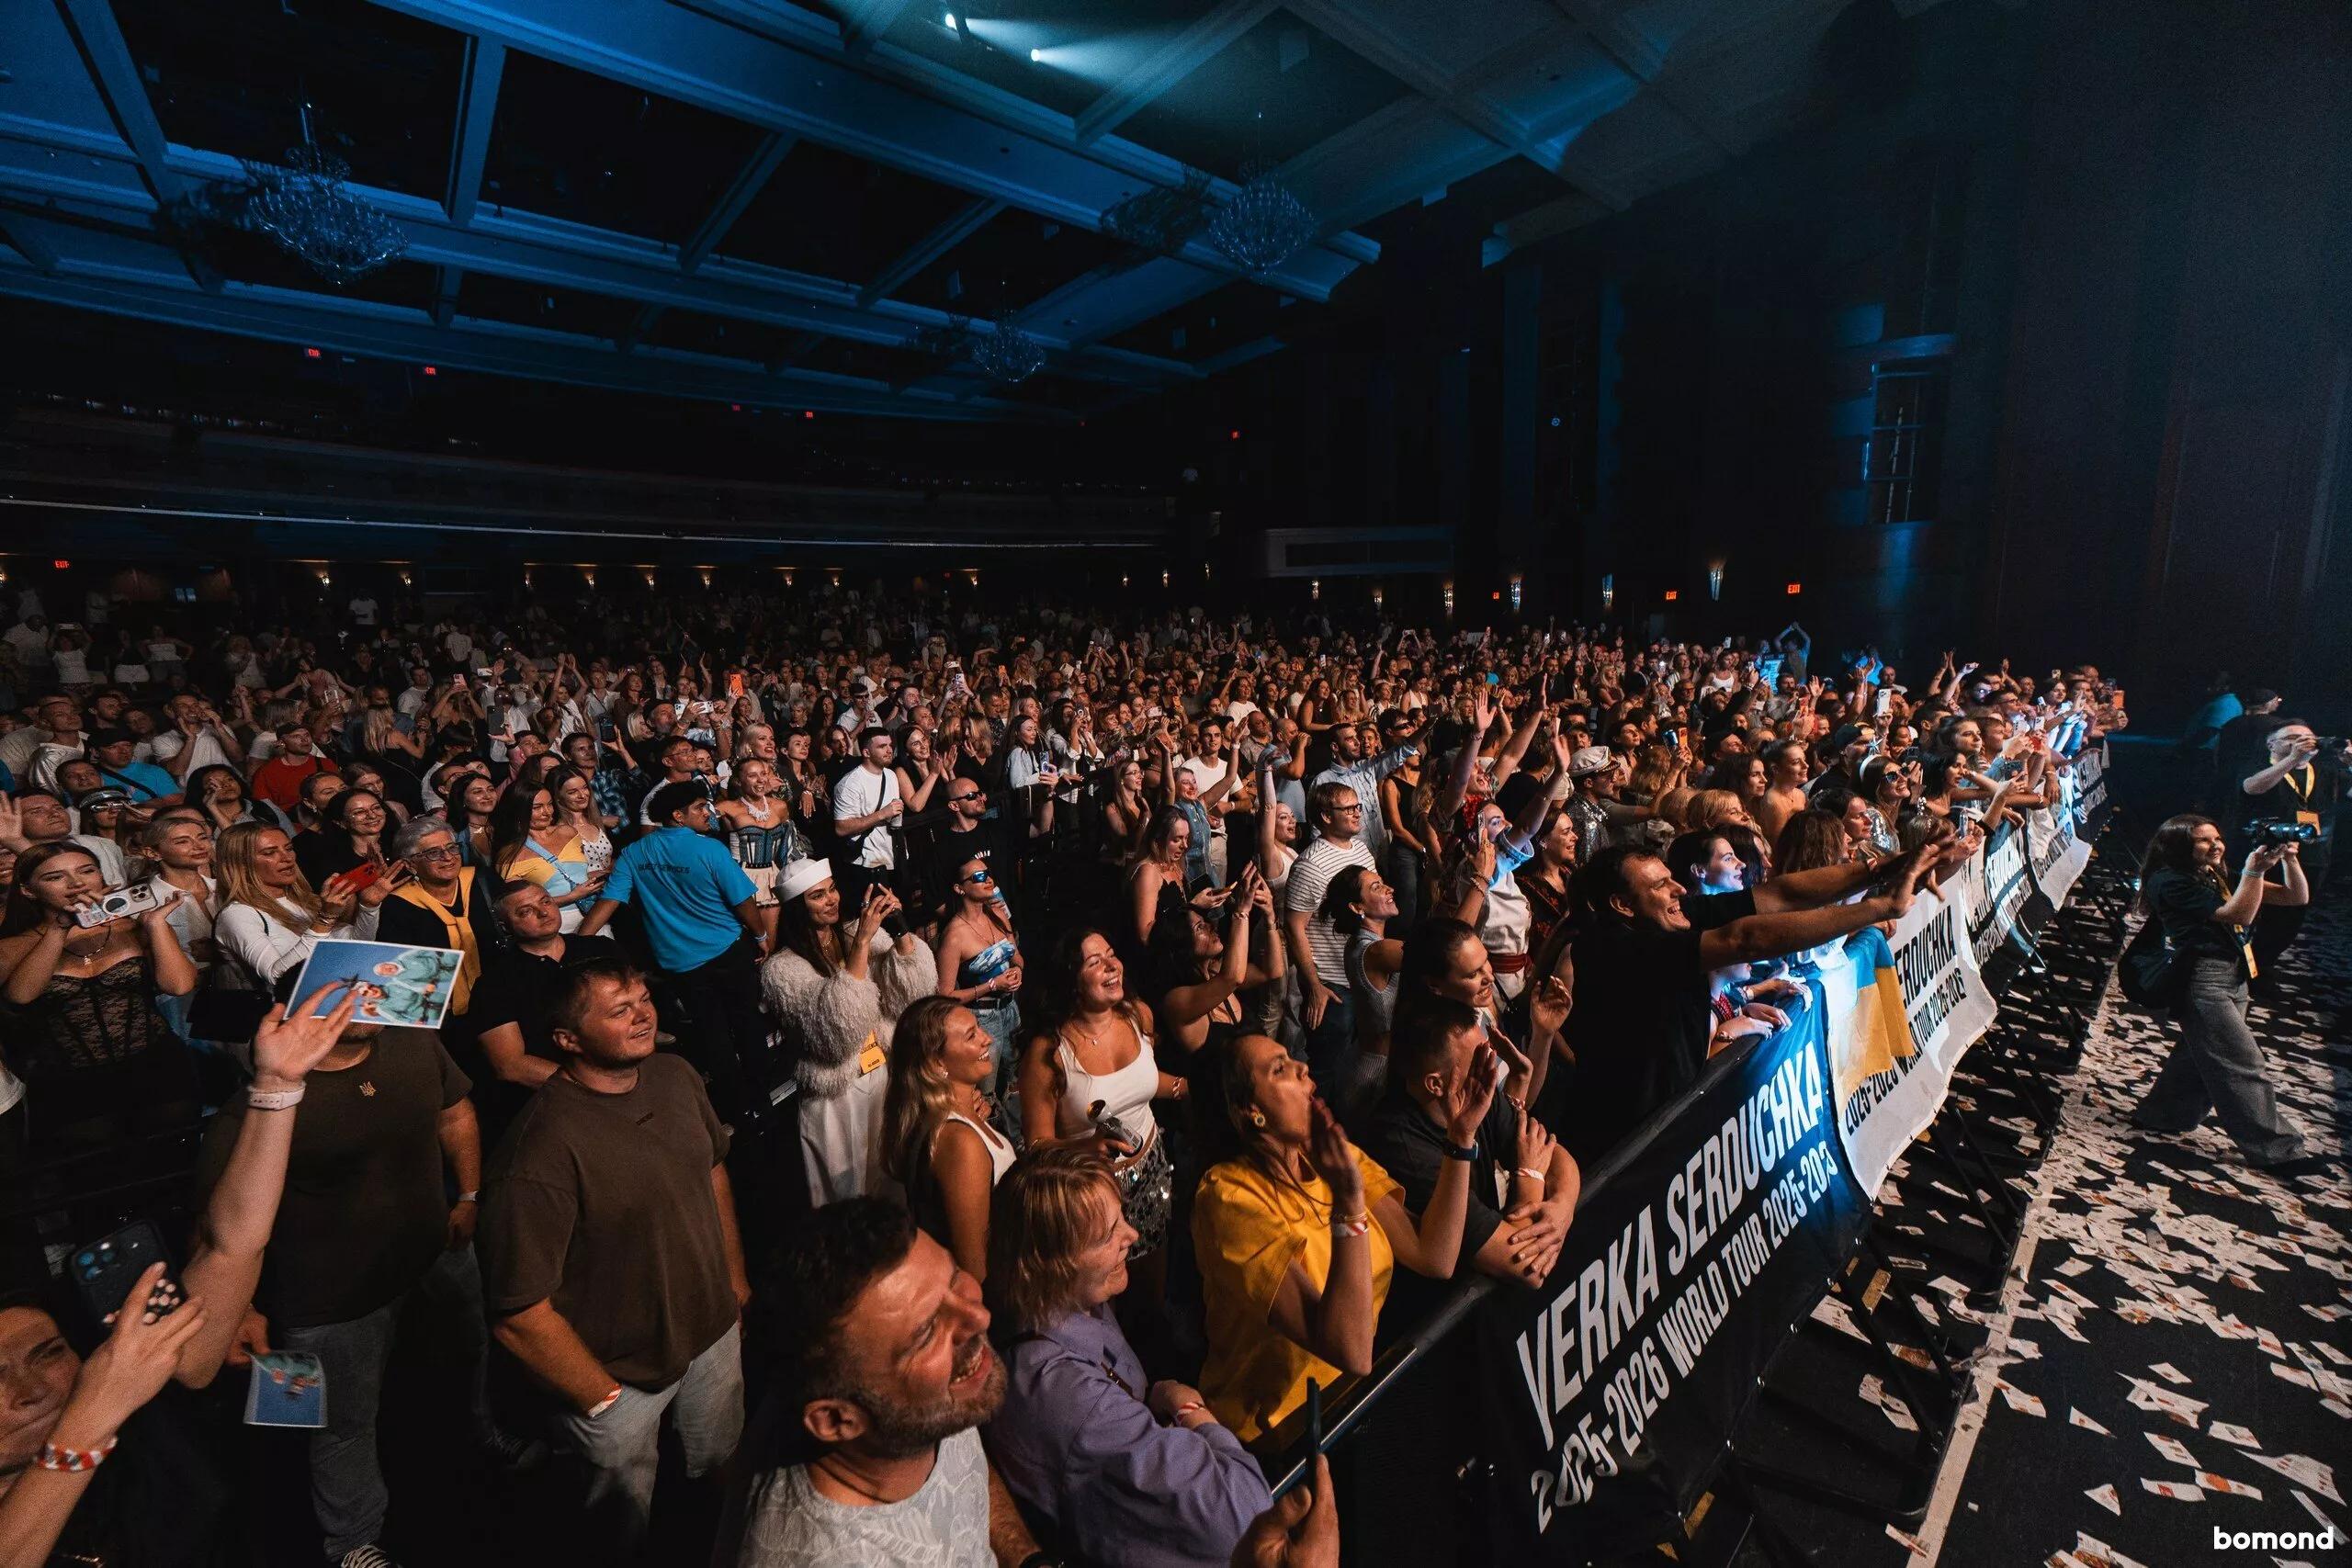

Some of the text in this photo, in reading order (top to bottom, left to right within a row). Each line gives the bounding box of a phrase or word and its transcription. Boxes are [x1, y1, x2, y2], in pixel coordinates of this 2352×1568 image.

[1788, 584, 1801, 593] EXIT
[1894, 905, 1957, 1010] ERDUCHKA
[1894, 1021, 1924, 1077] WLD
[1913, 1002, 1934, 1047] TOUR
[1515, 1042, 1824, 1452] VERKA SERDUCHKA
[1532, 1336, 1670, 1535] 2025-2026
[1657, 1262, 1732, 1380] WORLD
[1721, 1214, 1772, 1287] TOUR
